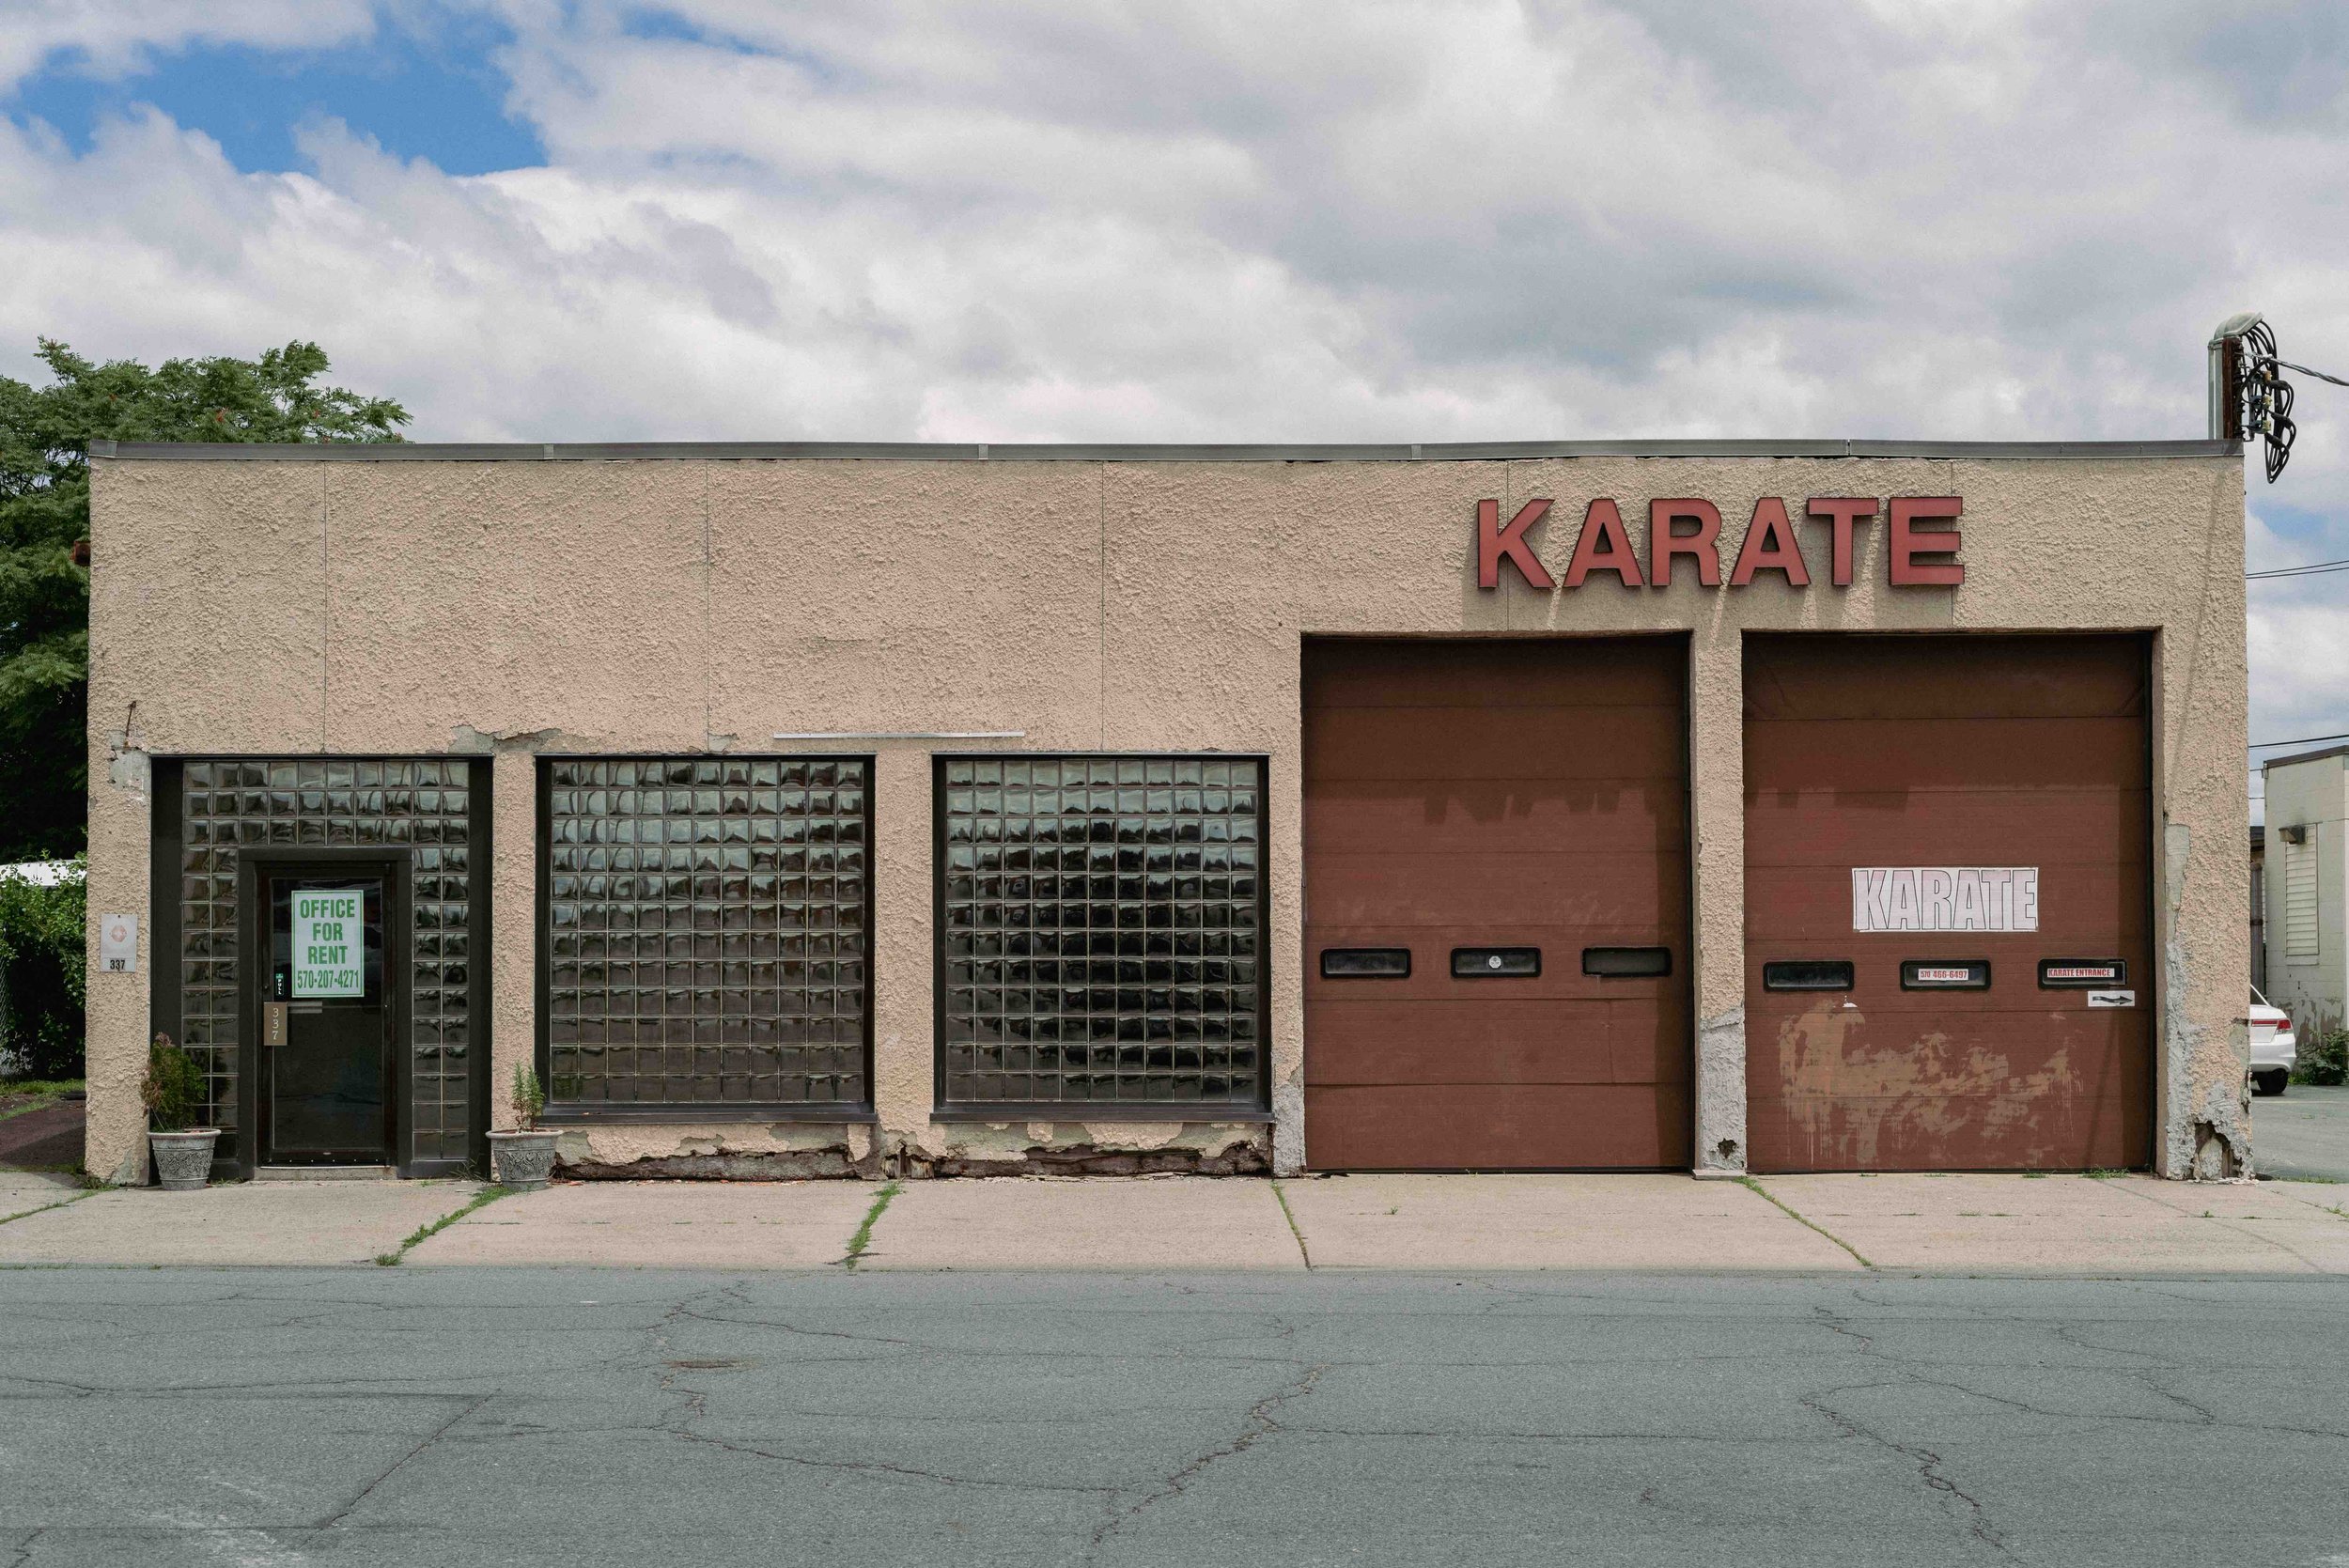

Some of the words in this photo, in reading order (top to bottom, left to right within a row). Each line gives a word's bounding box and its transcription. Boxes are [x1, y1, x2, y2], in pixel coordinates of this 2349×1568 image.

[1477, 497, 1965, 588] KARATE
[300, 899, 355, 919] OFFICE
[1854, 870, 2037, 930] KARATE
[312, 923, 343, 940] FOR
[307, 946, 348, 964] RENT
[110, 959, 125, 970] 337
[2048, 969, 2075, 977] KARATE
[2076, 969, 2111, 977] ENTRANCE
[297, 970, 359, 988] 570-207-4271
[1933, 970, 1967, 979] 466-6497
